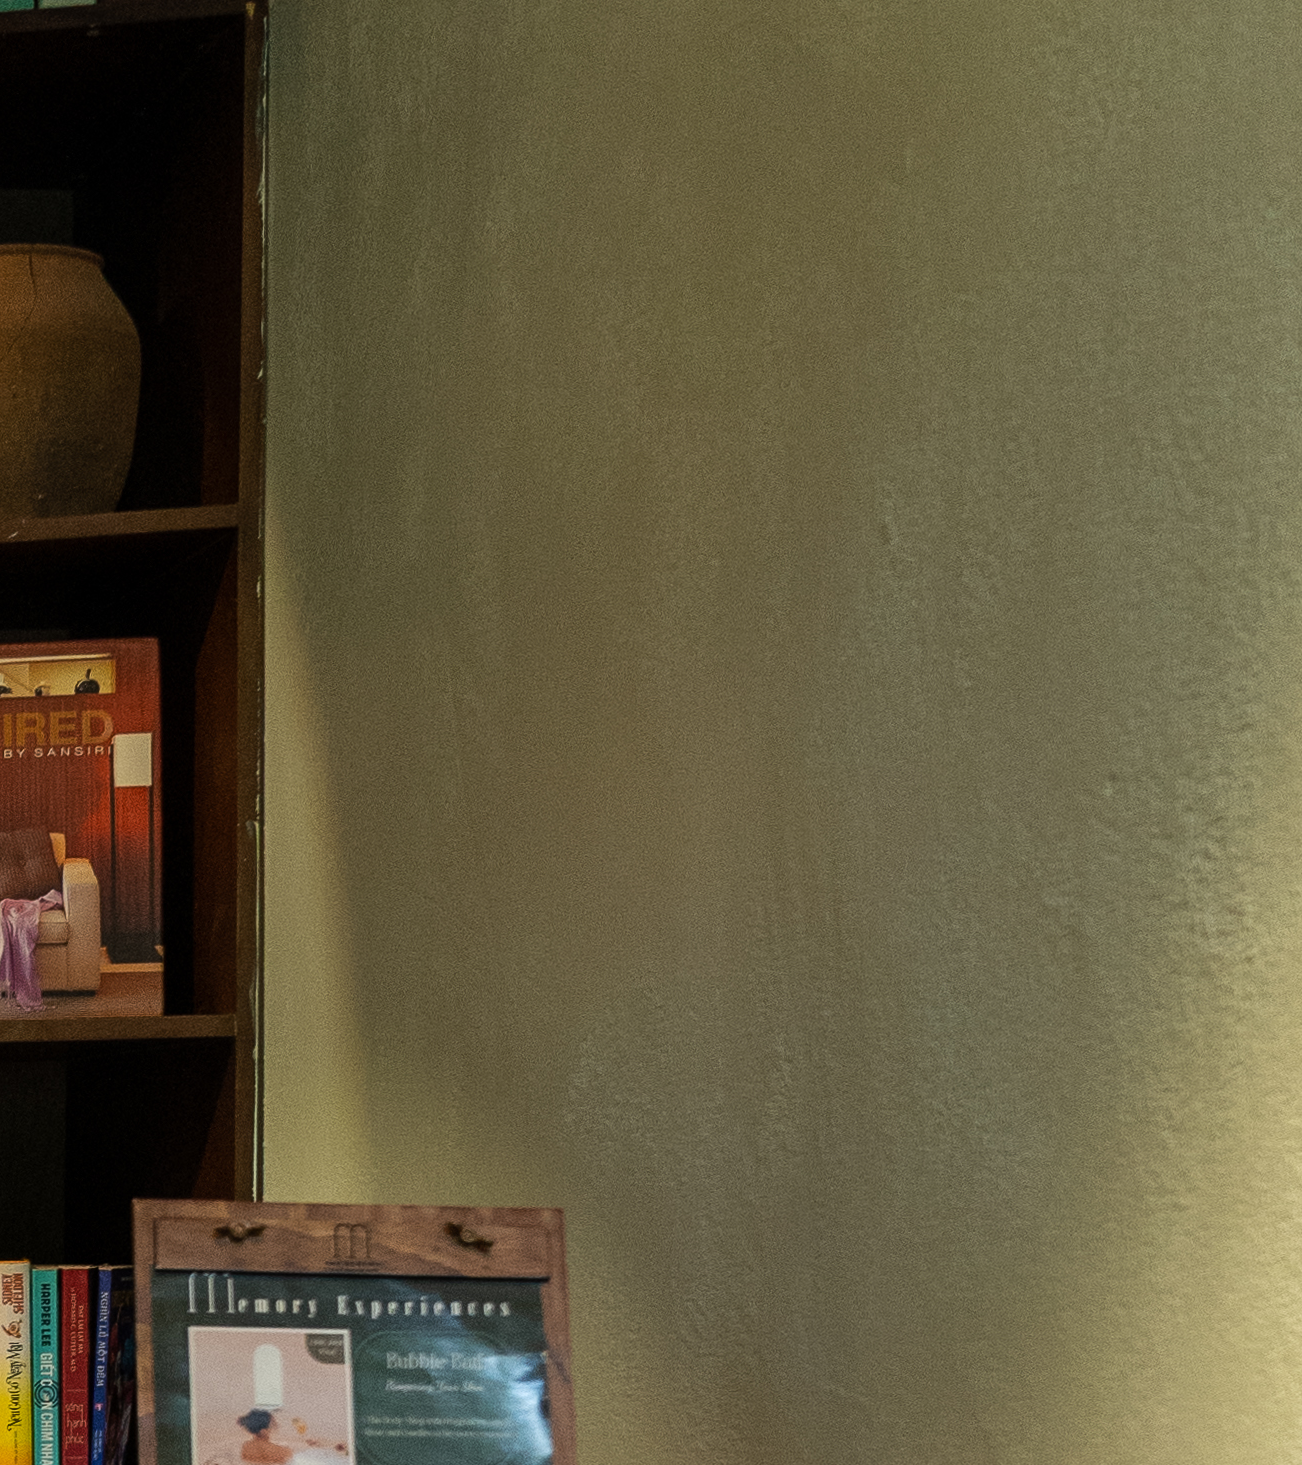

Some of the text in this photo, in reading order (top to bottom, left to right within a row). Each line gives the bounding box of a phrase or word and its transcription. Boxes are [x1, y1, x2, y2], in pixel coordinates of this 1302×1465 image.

[2, 745, 113, 760] BY SANSIRI
[40, 1283, 51, 1347] HARPER LEE
[336, 1294, 512, 1320] Experiences
